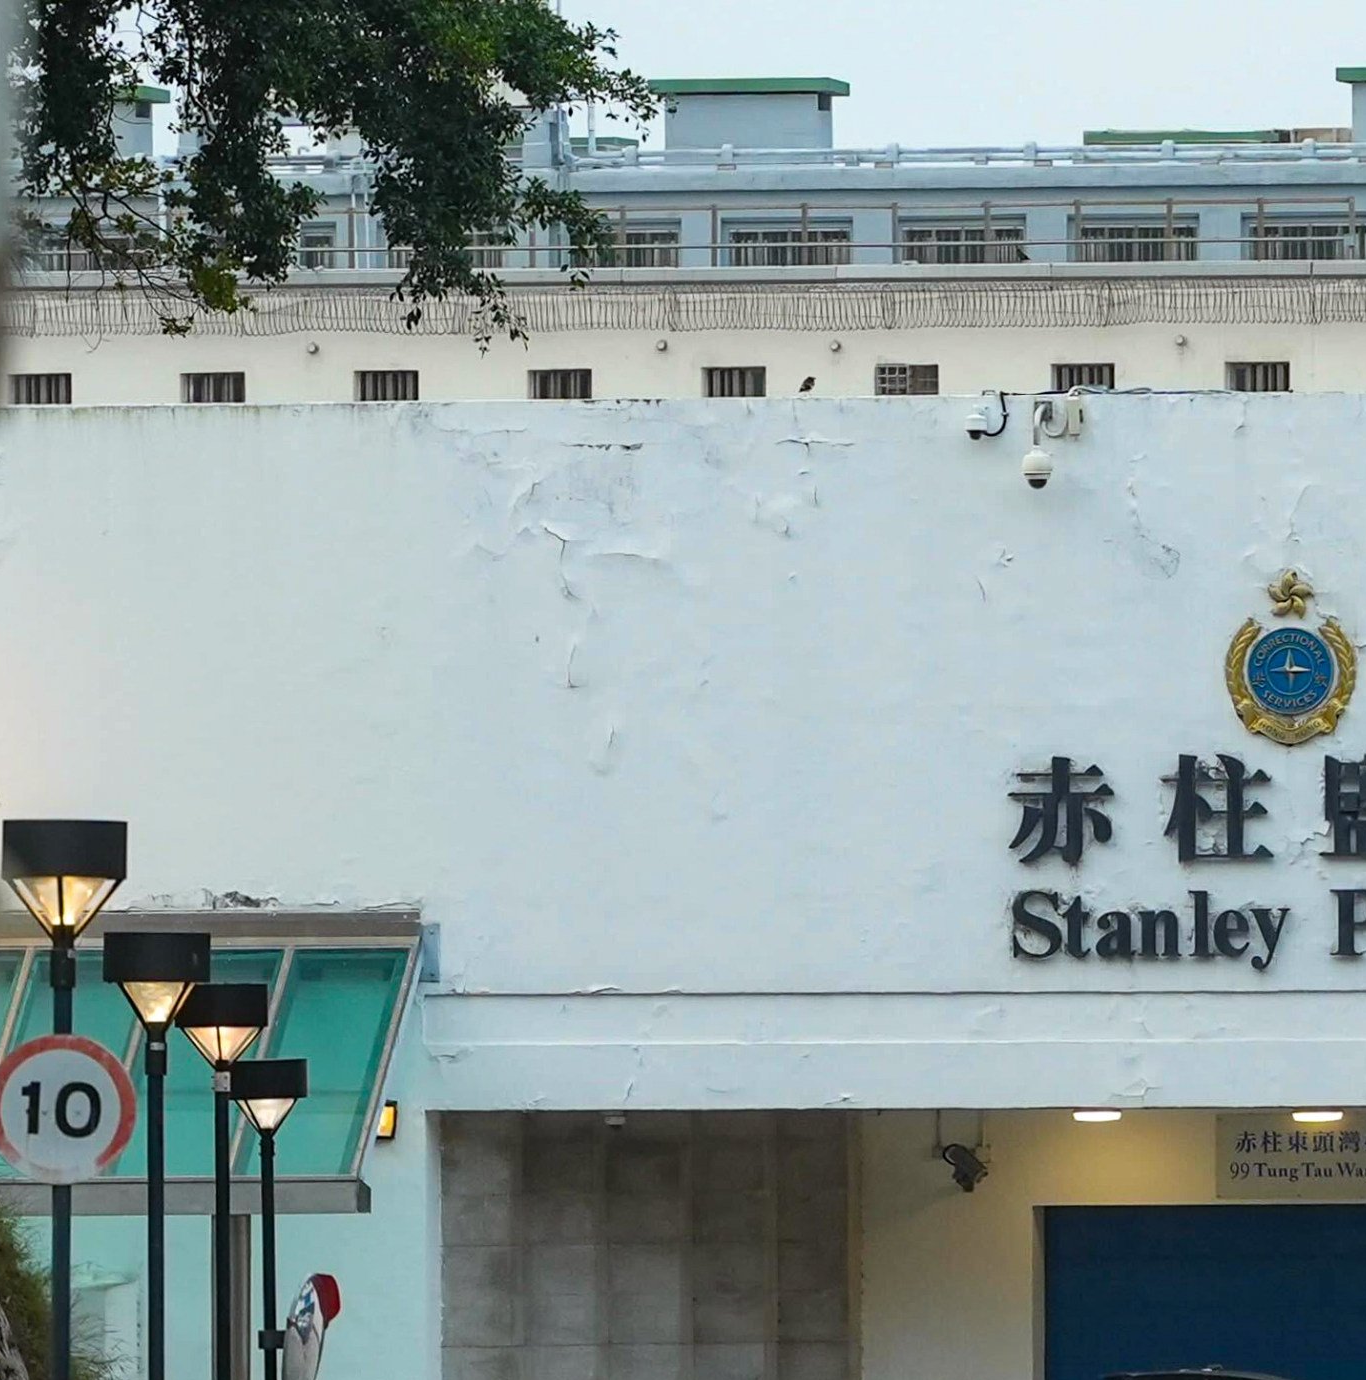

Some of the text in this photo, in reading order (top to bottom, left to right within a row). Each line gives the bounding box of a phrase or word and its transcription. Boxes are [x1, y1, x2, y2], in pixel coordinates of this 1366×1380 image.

[1254, 633, 1325, 666] CORRECTIONAL
[1263, 690, 1317, 708] SERVICES
[1012, 889, 1291, 970] Stanley
[21, 1081, 102, 1138] 10
[1229, 1161, 1250, 1180] 99
[1253, 1162, 1299, 1181] Tung
[1302, 1162, 1332, 1178] Tau
